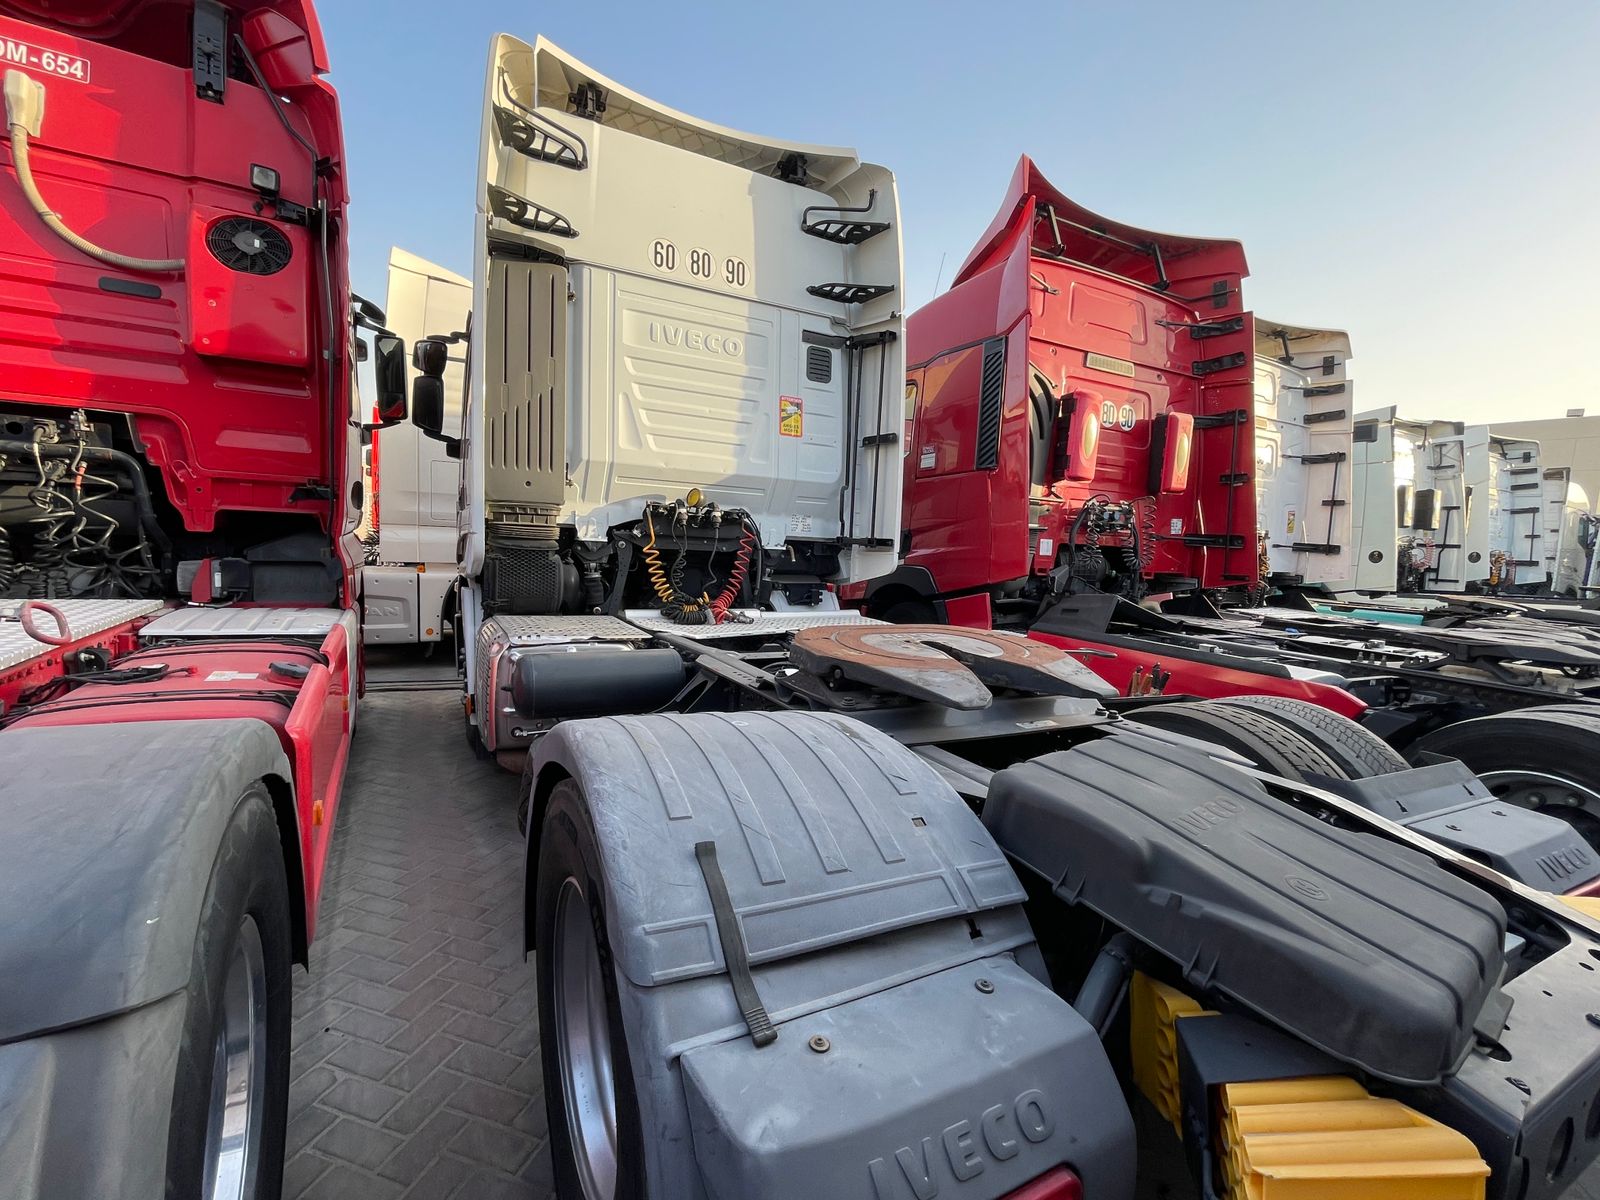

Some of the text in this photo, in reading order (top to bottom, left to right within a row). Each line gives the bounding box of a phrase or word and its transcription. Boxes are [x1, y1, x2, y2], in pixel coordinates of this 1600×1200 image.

[654, 241, 745, 286] 60 80 90
[649, 321, 744, 357] IVECO
[1102, 403, 1134, 428] 80 90
[1172, 795, 1246, 836] IVECO
[1535, 844, 1591, 882] IVECO
[868, 1088, 1056, 1200] IVECO
